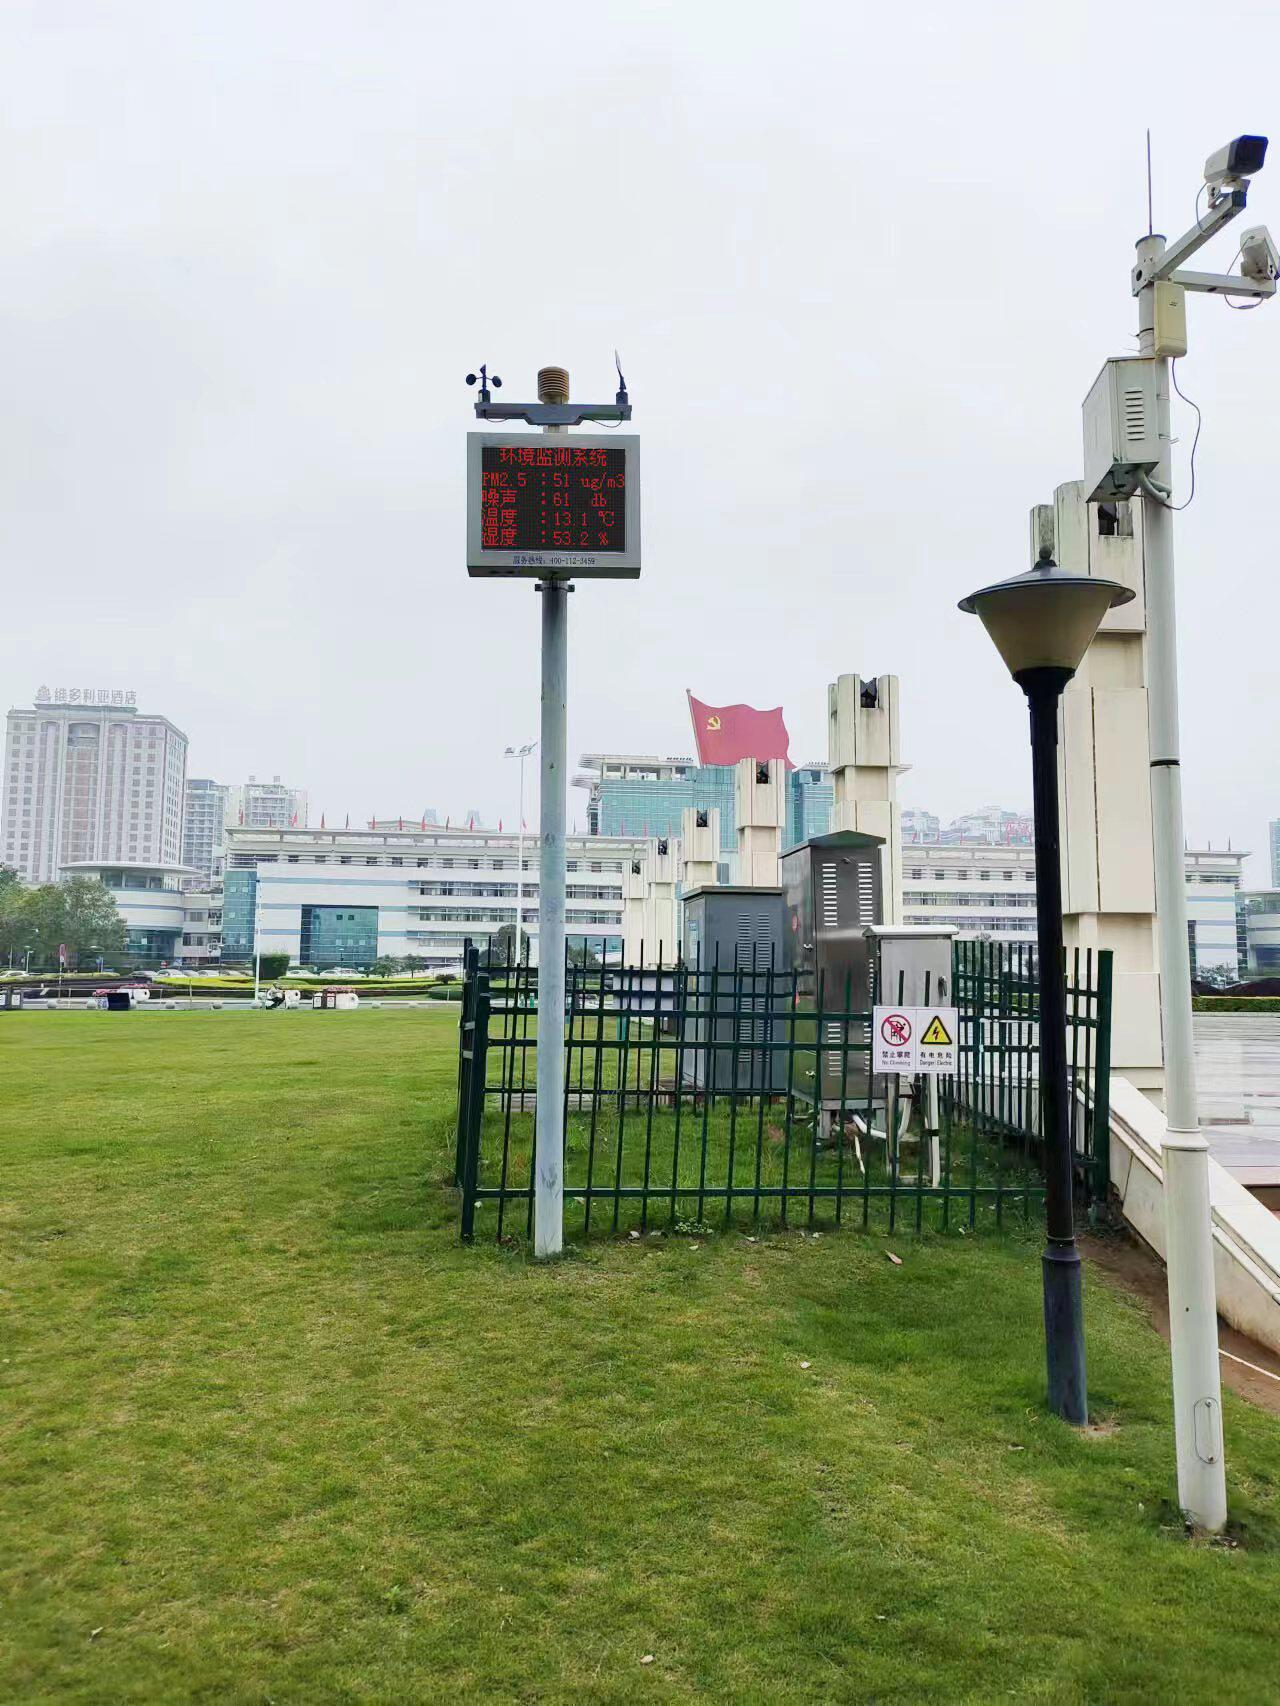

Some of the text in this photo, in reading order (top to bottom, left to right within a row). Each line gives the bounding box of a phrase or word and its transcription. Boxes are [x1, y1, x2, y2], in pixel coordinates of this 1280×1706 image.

[500, 447, 607, 467] 环境监测系统
[482, 472, 527, 487] PM2.5
[482, 488, 517, 508] 噪声
[482, 508, 518, 527] 温度
[482, 528, 518, 547] 湿度
[54, 687, 137, 705] 维多利亚酒店
